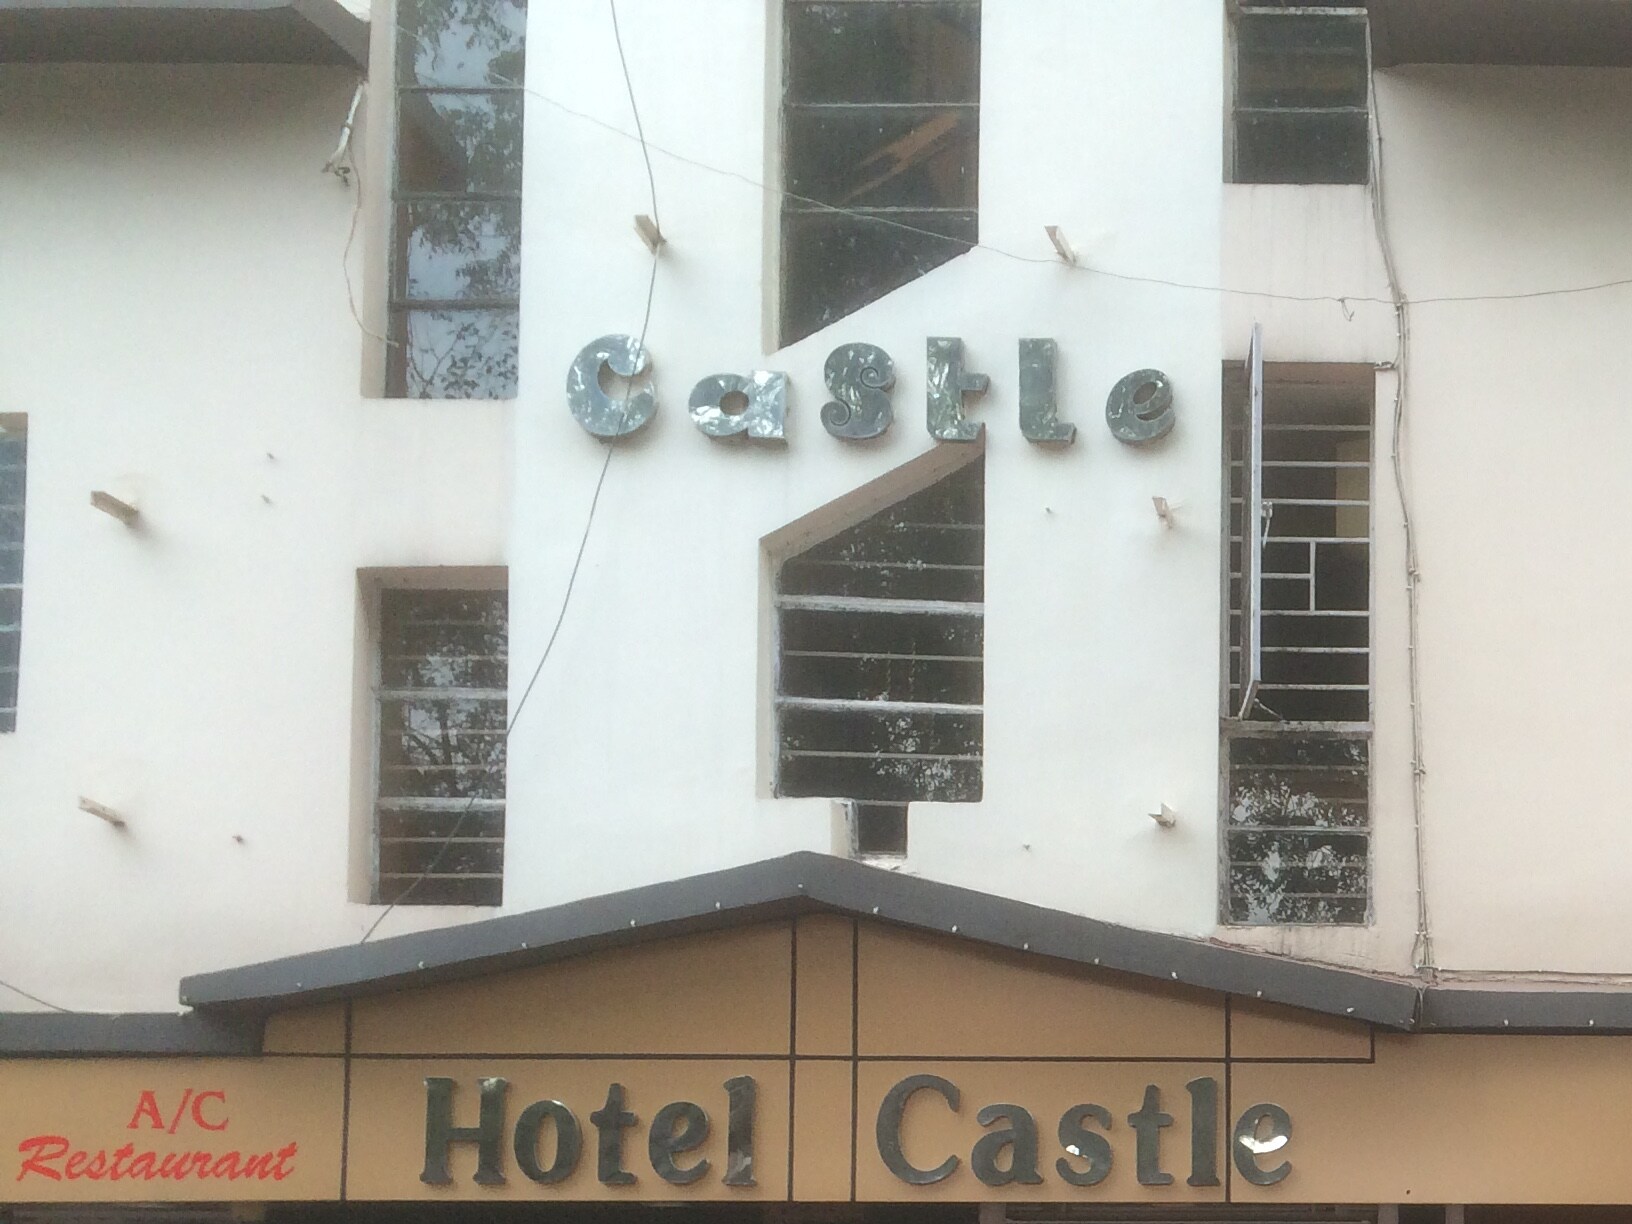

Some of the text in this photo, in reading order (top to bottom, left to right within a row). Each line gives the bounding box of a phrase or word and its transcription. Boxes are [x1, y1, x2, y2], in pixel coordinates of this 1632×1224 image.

[127, 1088, 229, 1135] A/C
[420, 1074, 1293, 1187] Hotel Castle
[16, 1135, 298, 1181] Restaurant
